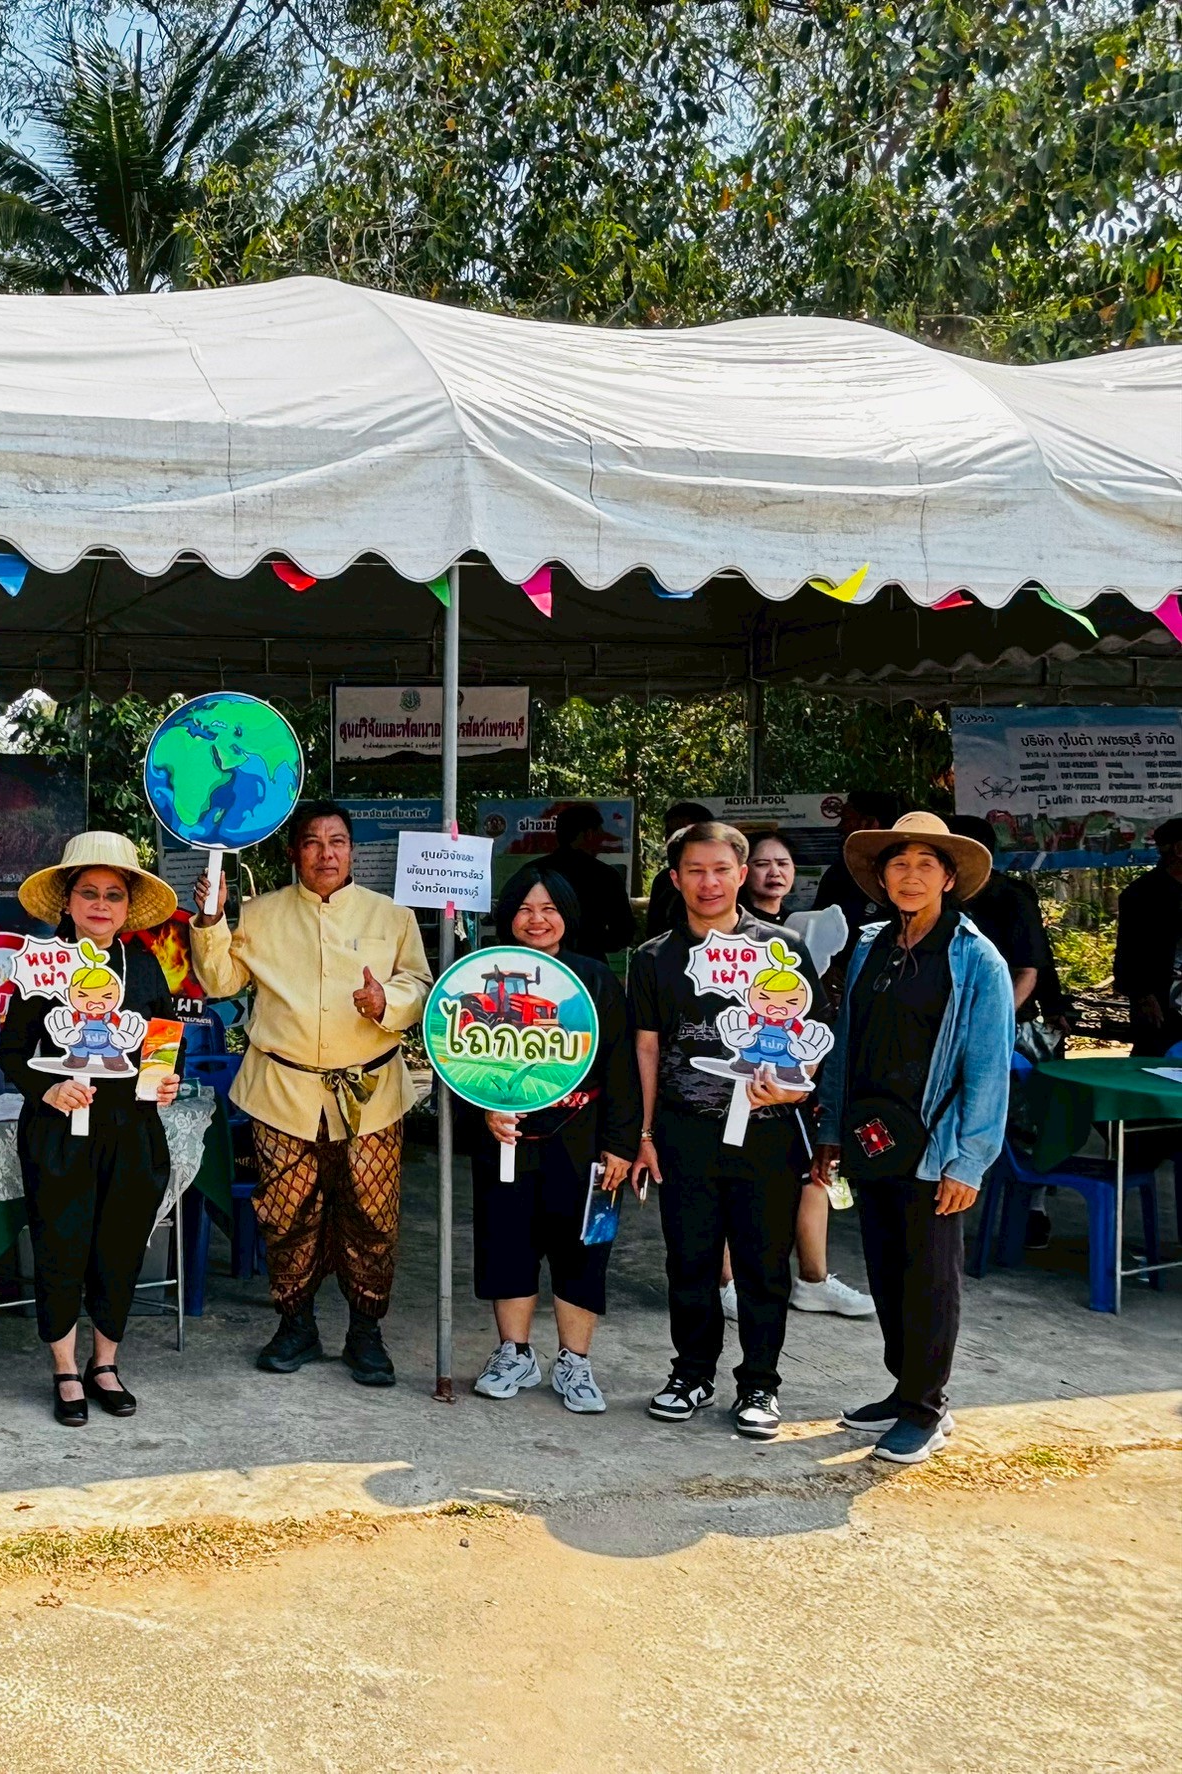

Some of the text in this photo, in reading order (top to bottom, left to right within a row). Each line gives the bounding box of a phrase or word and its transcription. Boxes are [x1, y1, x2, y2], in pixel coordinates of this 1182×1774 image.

[1020, 733, 1054, 747] บริษัท
[1146, 731, 1175, 745] จำกัด
[724, 795, 786, 806] MOTOR POOL
[24, 950, 71, 973] หยุด
[705, 948, 757, 969] หยุด
[34, 972, 67, 987] เผา
[712, 970, 749, 983] เผา
[441, 999, 583, 1063] ไถกลบ
